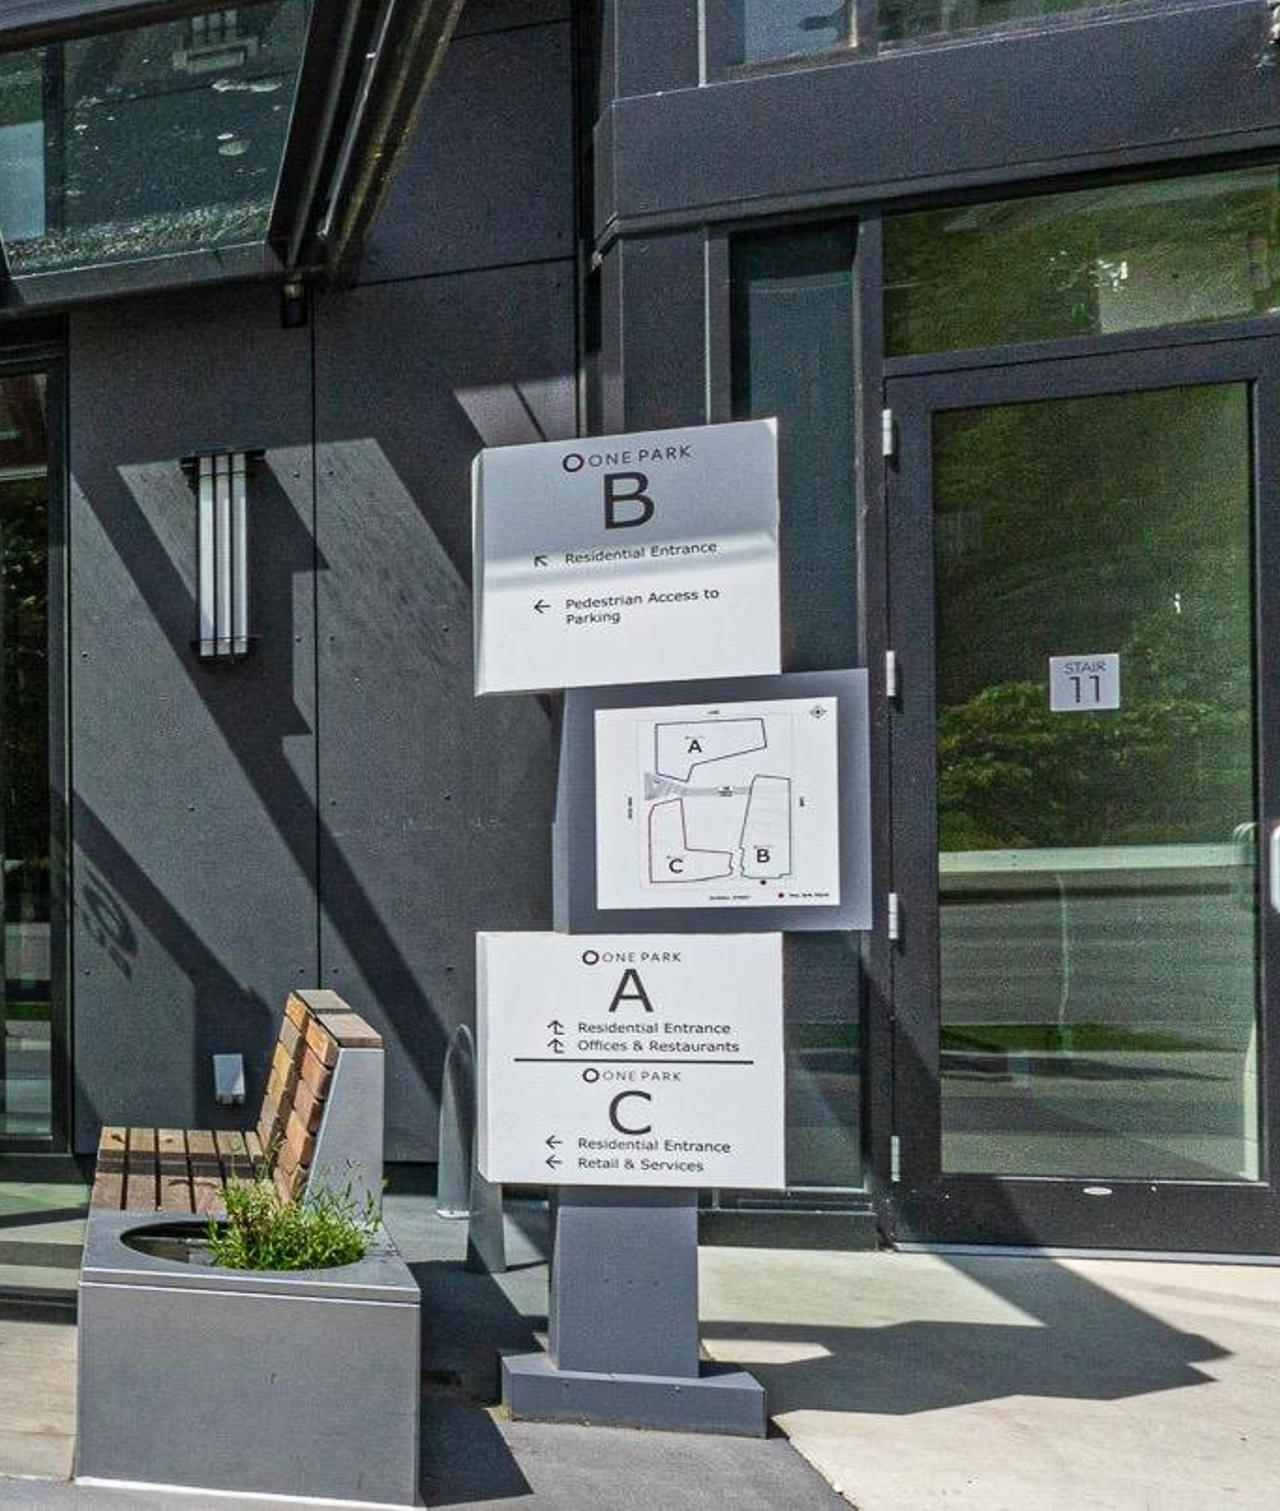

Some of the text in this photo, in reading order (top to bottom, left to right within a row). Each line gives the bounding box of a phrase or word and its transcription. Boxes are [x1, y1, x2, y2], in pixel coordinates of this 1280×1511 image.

[589, 444, 692, 468] ONE PARK
[603, 471, 655, 530] B
[565, 541, 717, 565] Residential Entrance
[565, 589, 720, 610] Pedestrian Access to
[565, 611, 621, 625] Parking
[1064, 660, 1108, 676] STAIR
[1069, 675, 1100, 704] 11
[687, 739, 702, 754] A
[756, 849, 770, 863] B
[668, 858, 684, 874] C
[602, 951, 682, 963] ONE PARK
[608, 968, 654, 1013] A
[578, 1022, 731, 1034] Residential Entrance
[578, 1039, 740, 1053] Offices & Restaurants
[602, 1071, 682, 1082] ONE PARK
[608, 1090, 652, 1136] C
[578, 1138, 731, 1153] Residential Entrance
[578, 1158, 704, 1172] Retail & Services
